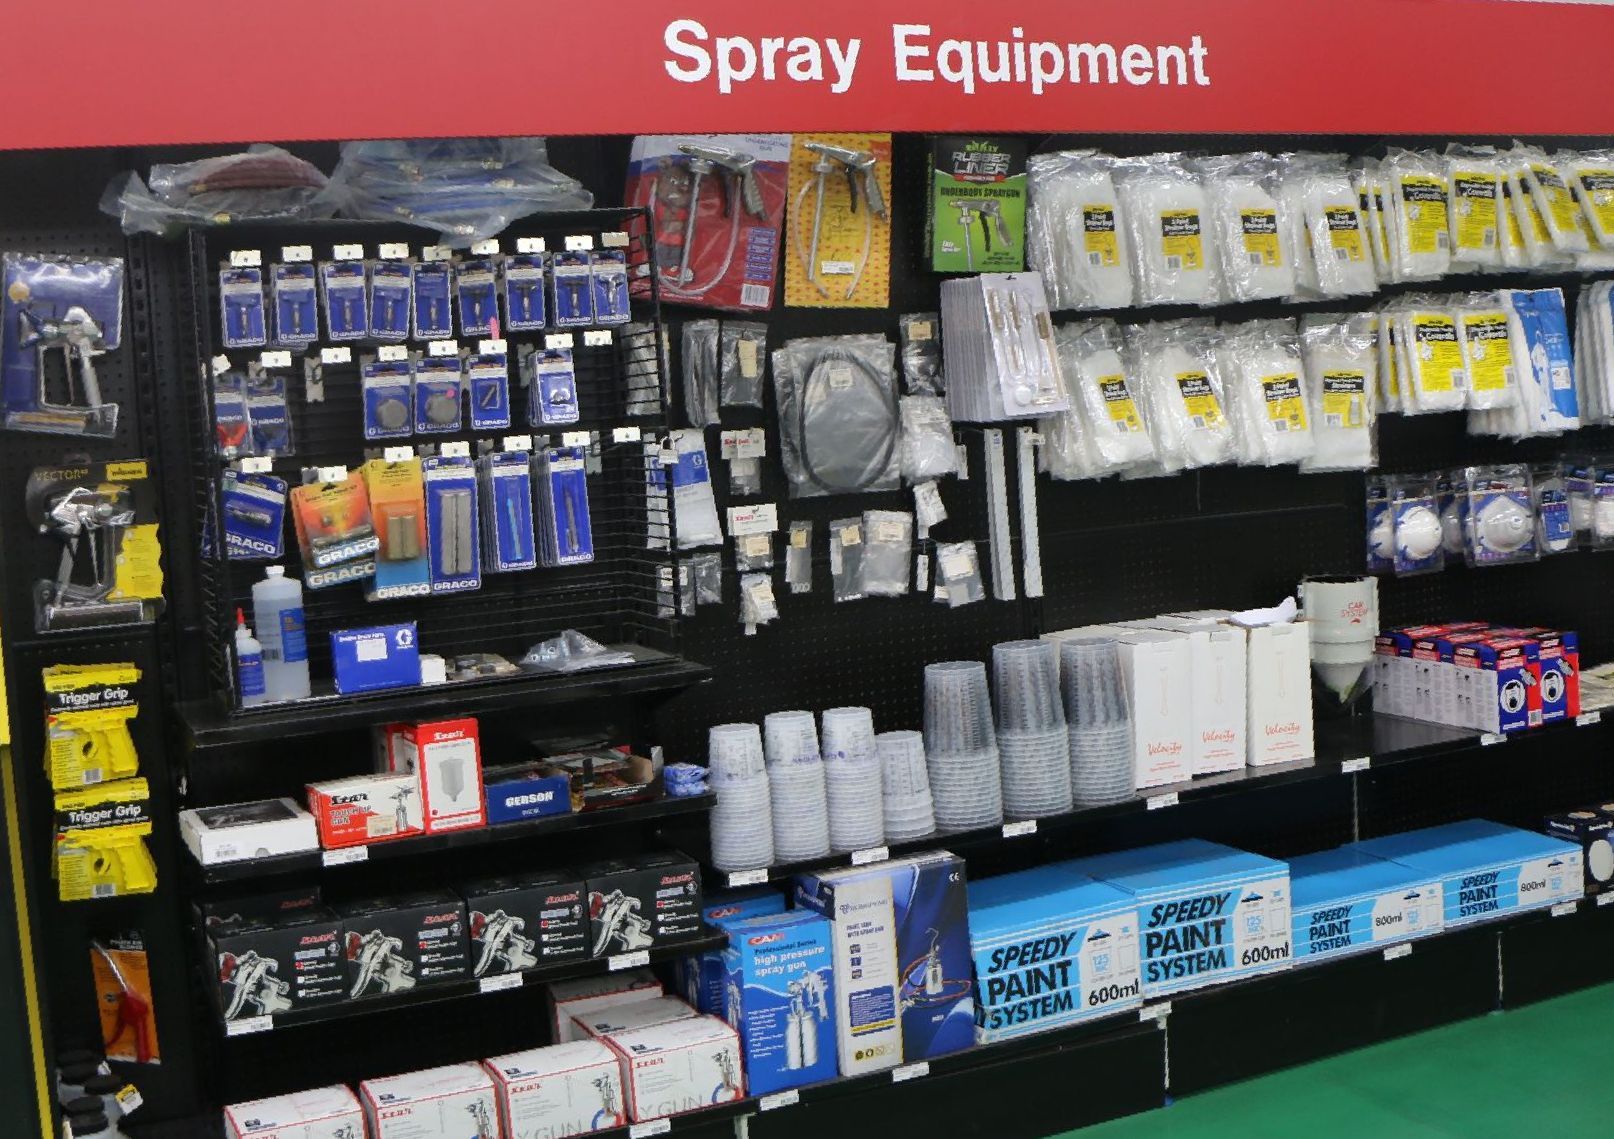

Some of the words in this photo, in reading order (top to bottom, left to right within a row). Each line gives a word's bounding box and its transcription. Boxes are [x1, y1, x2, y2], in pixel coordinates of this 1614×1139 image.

[663, 19, 860, 94] Spray
[893, 23, 1210, 95] Equipment
[952, 152, 1011, 162] RUBBER
[954, 162, 1009, 174] LINER
[318, 537, 380, 565] GRACO
[310, 561, 376, 585] GRACO
[377, 583, 430, 598] GRACO
[434, 579, 477, 591] GRACO
[59, 691, 101, 705] Trigger
[104, 687, 129, 700] Grip
[1202, 728, 1235, 744] Velocity
[1265, 721, 1301, 737] Velocity
[1147, 742, 1182, 757] Velocity
[505, 791, 554, 808] GERSON
[69, 809, 113, 823] Trigger
[115, 804, 141, 817] Grip
[1461, 872, 1500, 889] SPEEDY
[1520, 879, 1546, 893] 800ml
[1460, 885, 1498, 904] PAINT
[1147, 892, 1231, 928] SPEEDY
[1310, 905, 1353, 925] SPEEDY
[1460, 900, 1498, 917] SYSTEM
[1376, 912, 1402, 927] 800ml
[1146, 919, 1226, 958] PAINT
[1309, 919, 1350, 940] PAINT
[988, 930, 1076, 974] SPEEDY
[1242, 941, 1290, 966] 600ml
[1310, 937, 1351, 954] SYSTEM
[754, 955, 777, 966] high
[780, 947, 825, 962] pressure
[1147, 947, 1226, 982] SYSTEM
[755, 966, 784, 977] spray
[787, 961, 807, 973] gun
[987, 960, 1072, 1006] PAINT
[1088, 978, 1140, 1006] 600ml
[990, 990, 1073, 1029] SYSTEM
[656, 1094, 703, 1114] GUN
